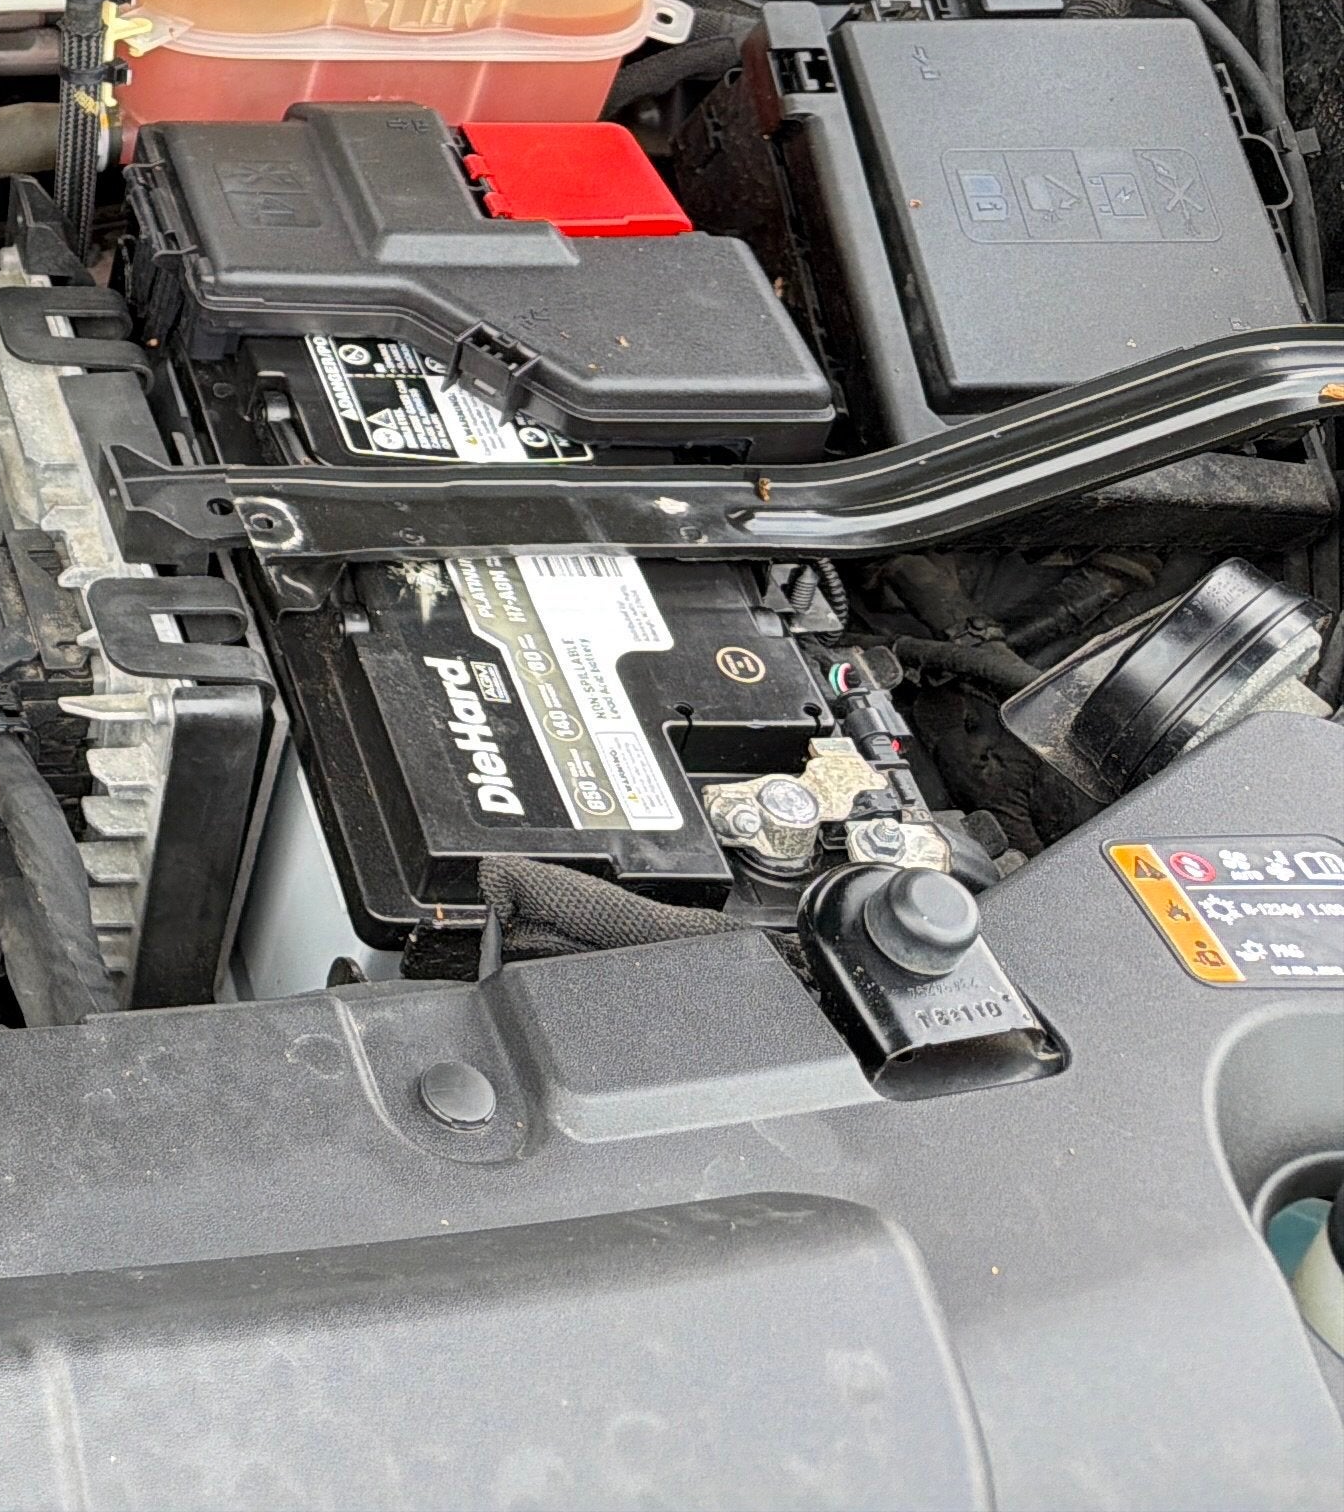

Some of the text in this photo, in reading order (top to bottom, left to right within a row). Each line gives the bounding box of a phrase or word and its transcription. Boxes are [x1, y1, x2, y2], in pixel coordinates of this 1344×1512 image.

[473, 663, 499, 699] AGM
[560, 637, 608, 720] NON-SPILLABLE
[422, 655, 526, 817] DieHard
[548, 709, 575, 737] 140
[577, 780, 607, 811] 850
